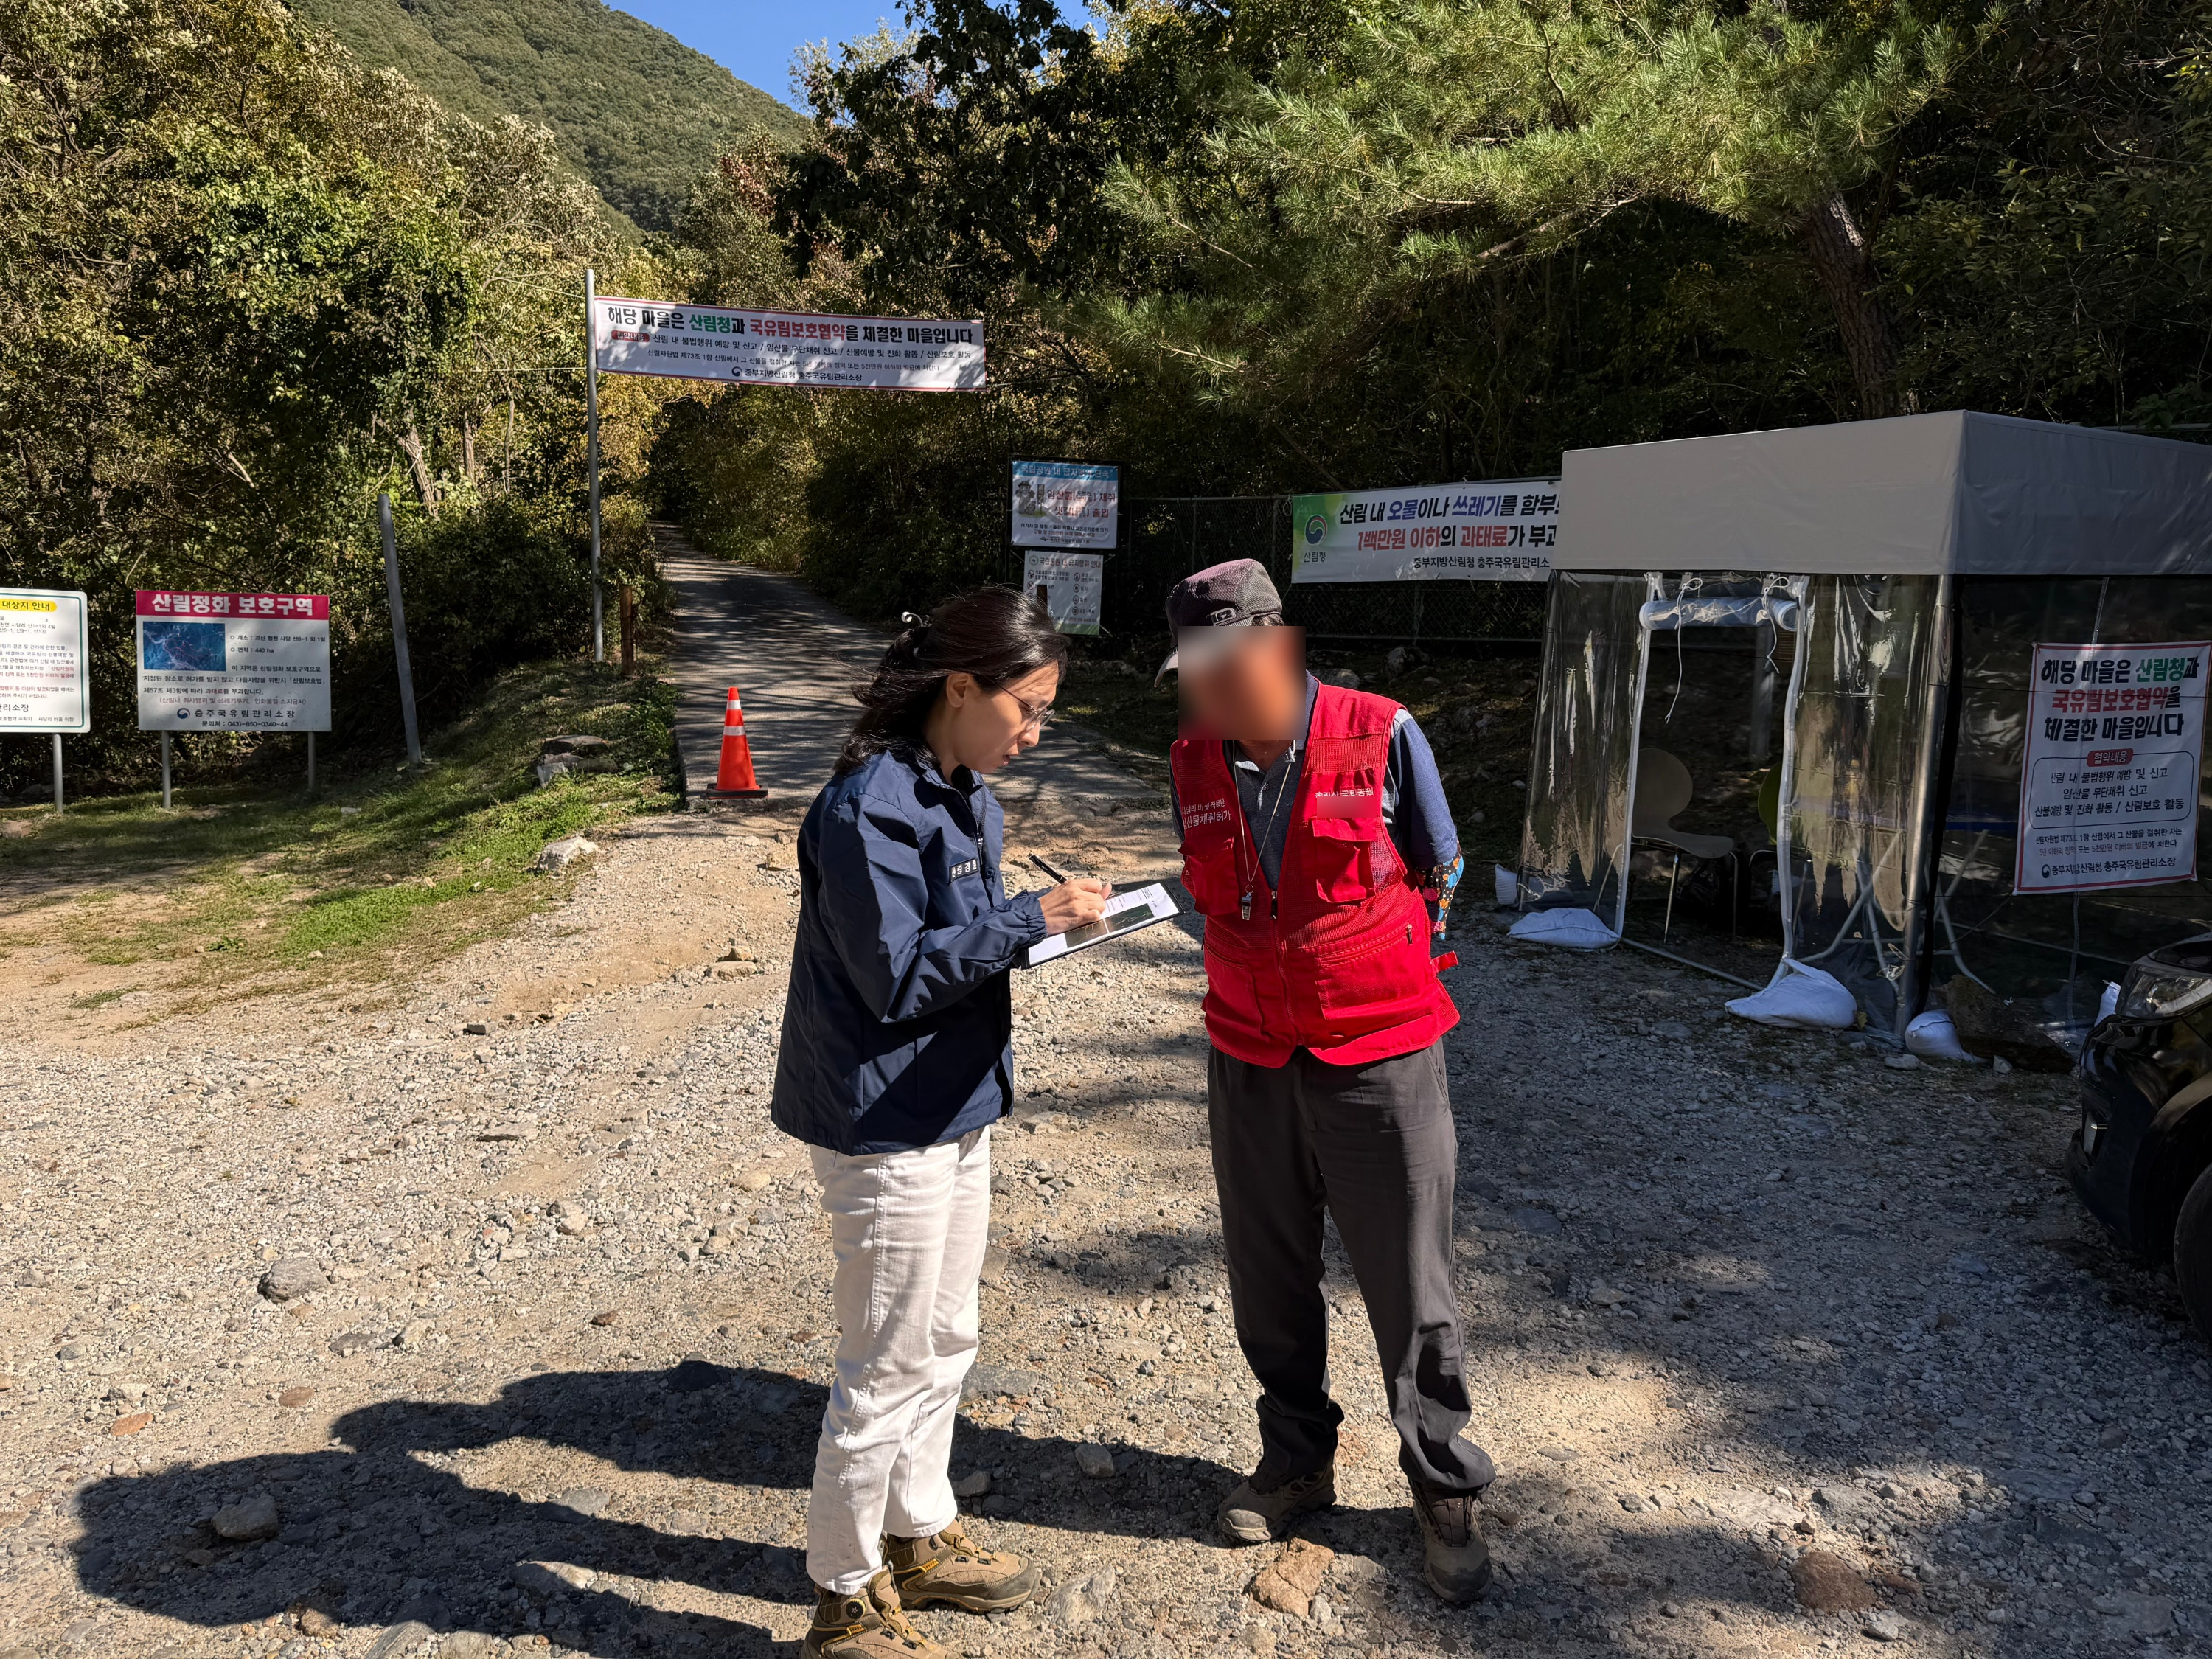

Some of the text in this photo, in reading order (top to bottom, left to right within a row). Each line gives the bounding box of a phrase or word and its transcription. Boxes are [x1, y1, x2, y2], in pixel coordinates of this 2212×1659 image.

[608, 307, 973, 344] 해당 마을은 산림청과 국유림보호협약을 체결한 마을입니다
[616, 332, 644, 341] 협약내용
[653, 335, 971, 359] 산림 내 불법행위 예방 및 신고 임산물 무단채취 신고 산불예방 및 진화 활동 산림보호 활동
[681, 352, 700, 360] 제73조
[714, 355, 739, 363] 산림에서
[745, 368, 862, 381] 중부지방산림청 충주국유림관리소장
[1340, 493, 1560, 524] 산림 내 오물이나 쓰레기를 함부
[1358, 527, 1406, 551] 1백만원
[1410, 525, 1456, 549] 이하의
[1461, 525, 1525, 547] 과태료가
[1304, 552, 1326, 563] 산림청
[1413, 555, 1550, 568] 중부지방산림청 충주국유림관리소
[2, 601, 50, 611] 대상지 안내
[152, 594, 313, 616] 산림정화 보호구역
[2042, 656, 2199, 684] 해당 마을은 산림청과
[2052, 685, 2180, 713] 국유림보호협약을
[2044, 713, 2184, 742] 체결한 마을입니다
[2095, 751, 2127, 765] 협약내용
[2051, 768, 2168, 783] 산림 내 불법행위 예방 및 신고
[2063, 785, 2147, 799] 임산물 무단채취 신고
[1197, 802, 1209, 811] 버섯
[2035, 804, 2062, 817] 산불예방
[2065, 804, 2073, 815] 및
[2076, 804, 2093, 815] 진화
[2096, 802, 2112, 814] 활동
[2125, 799, 2160, 812] 산림보호
[2165, 798, 2184, 810] 활동
[2080, 833, 2089, 841] 1항
[2091, 832, 2115, 841] 산림에서
[2078, 845, 2090, 853] 또는
[2052, 857, 2176, 876] 중부지방산림청 충주국유림관리소장
